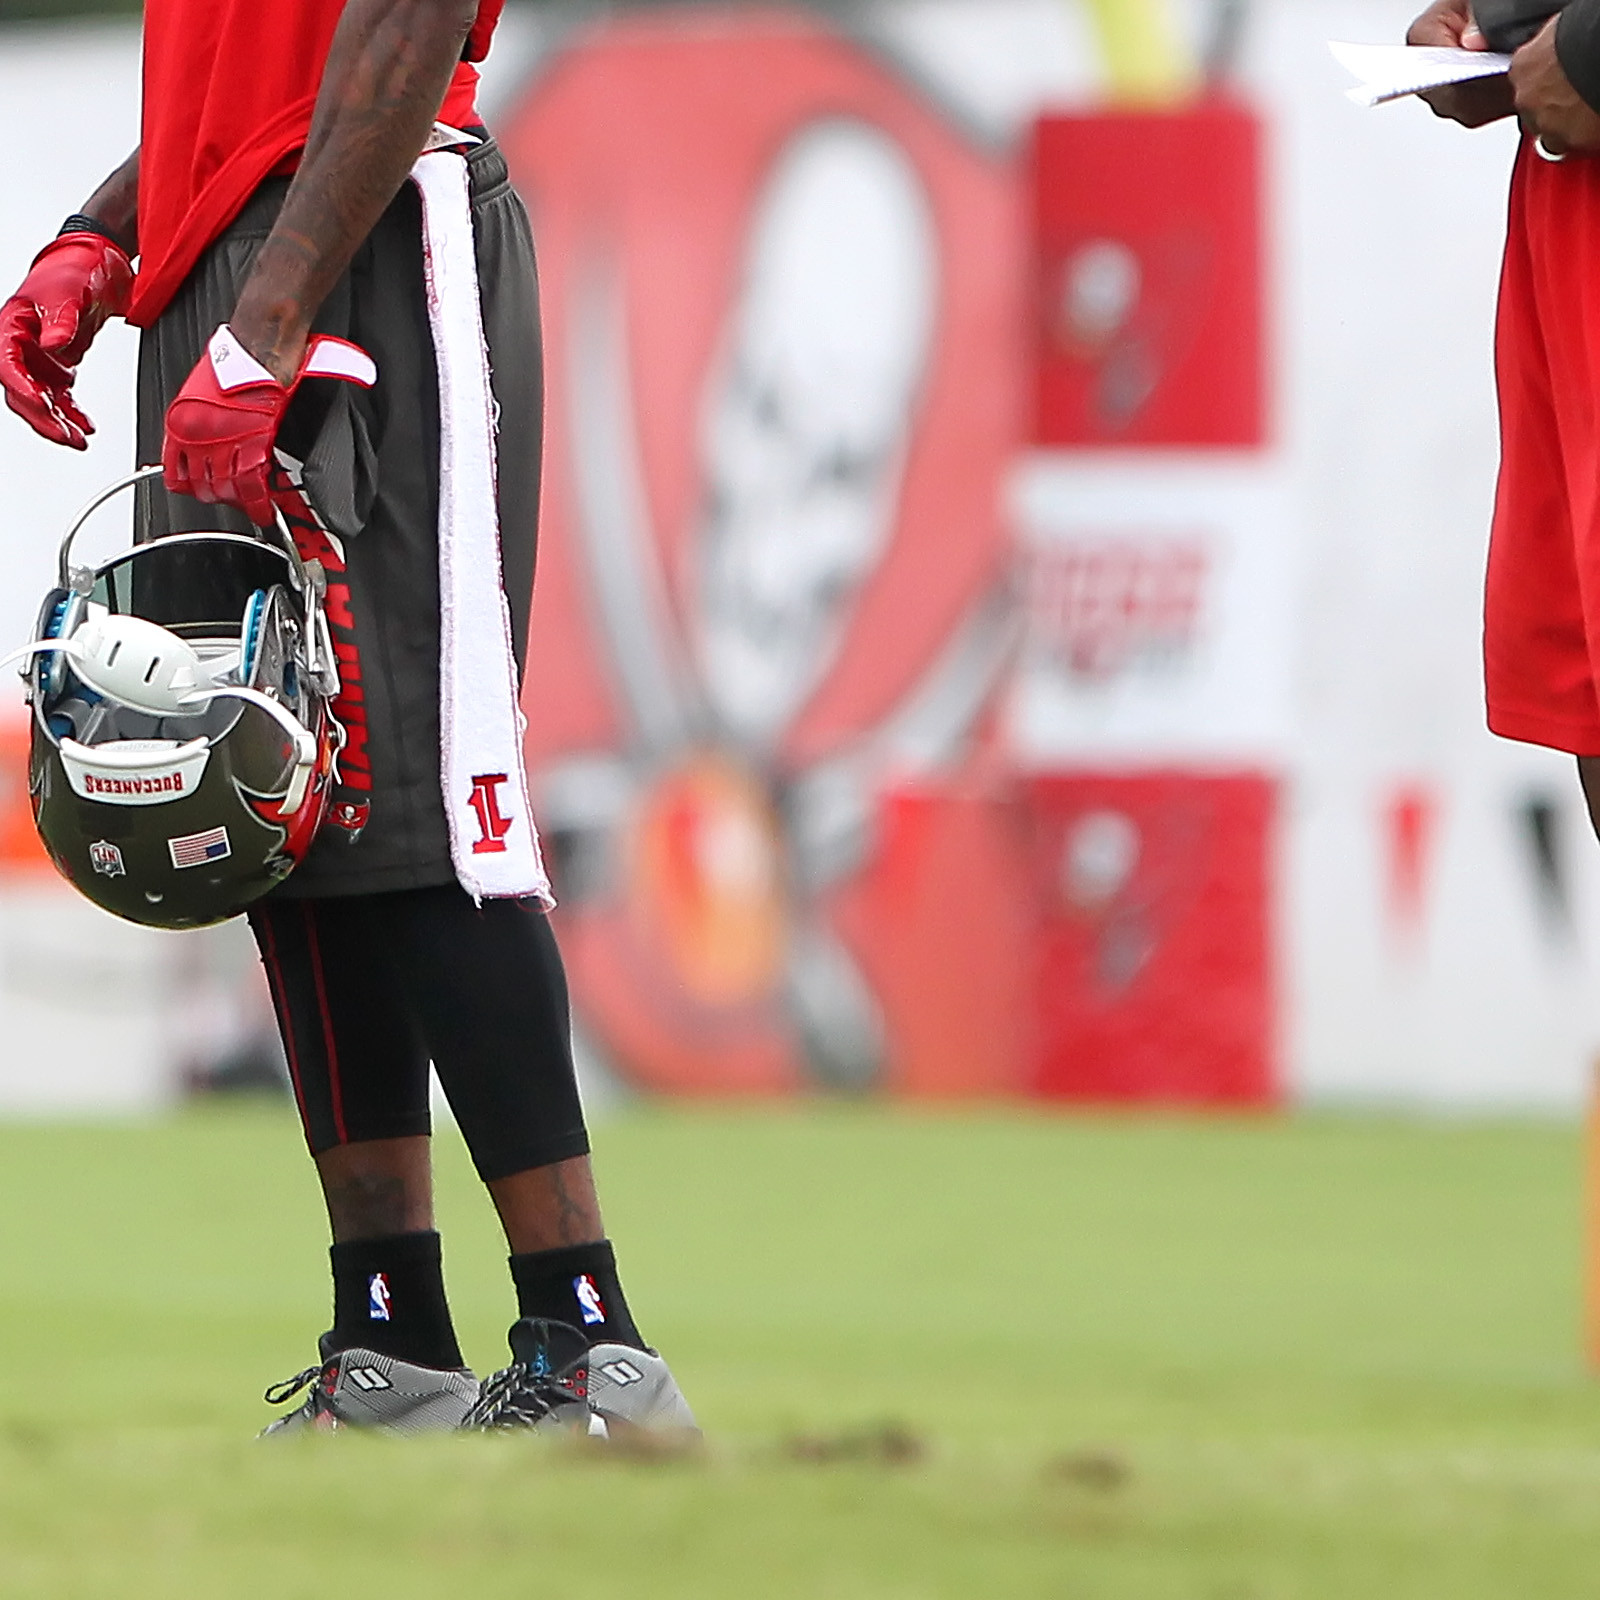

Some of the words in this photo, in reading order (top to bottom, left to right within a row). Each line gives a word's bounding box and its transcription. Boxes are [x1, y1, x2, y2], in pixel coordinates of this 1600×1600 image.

[84, 771, 184, 794] BUCCANEERS
[467, 773, 514, 854] 1
[92, 847, 117, 863] NFL
